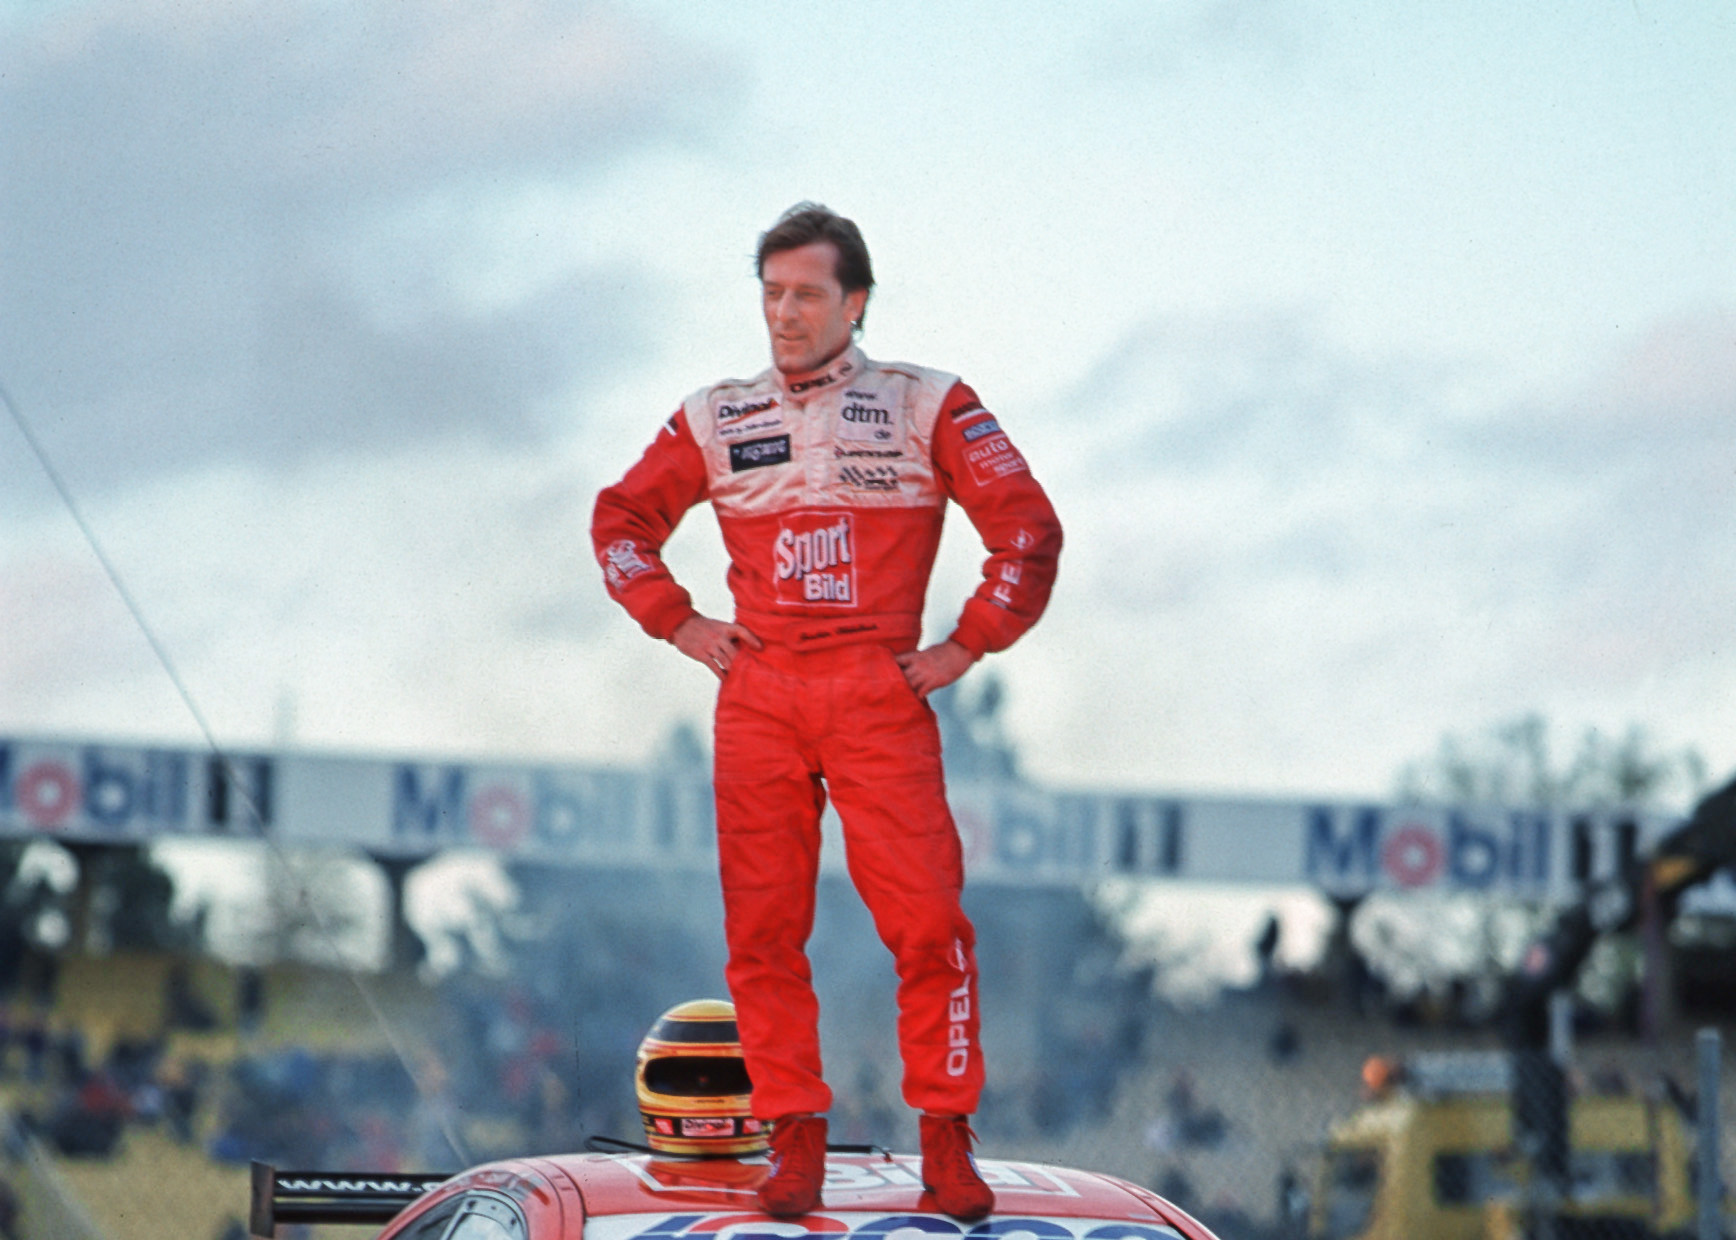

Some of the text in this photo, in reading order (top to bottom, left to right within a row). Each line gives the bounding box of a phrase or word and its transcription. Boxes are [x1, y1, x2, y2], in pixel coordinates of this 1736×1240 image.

[777, 517, 851, 580] Sport
[804, 573, 850, 601] Bild
[0, 741, 189, 832] obil
[1304, 805, 1549, 888] Mobil
[946, 974, 971, 1077] OPEL
